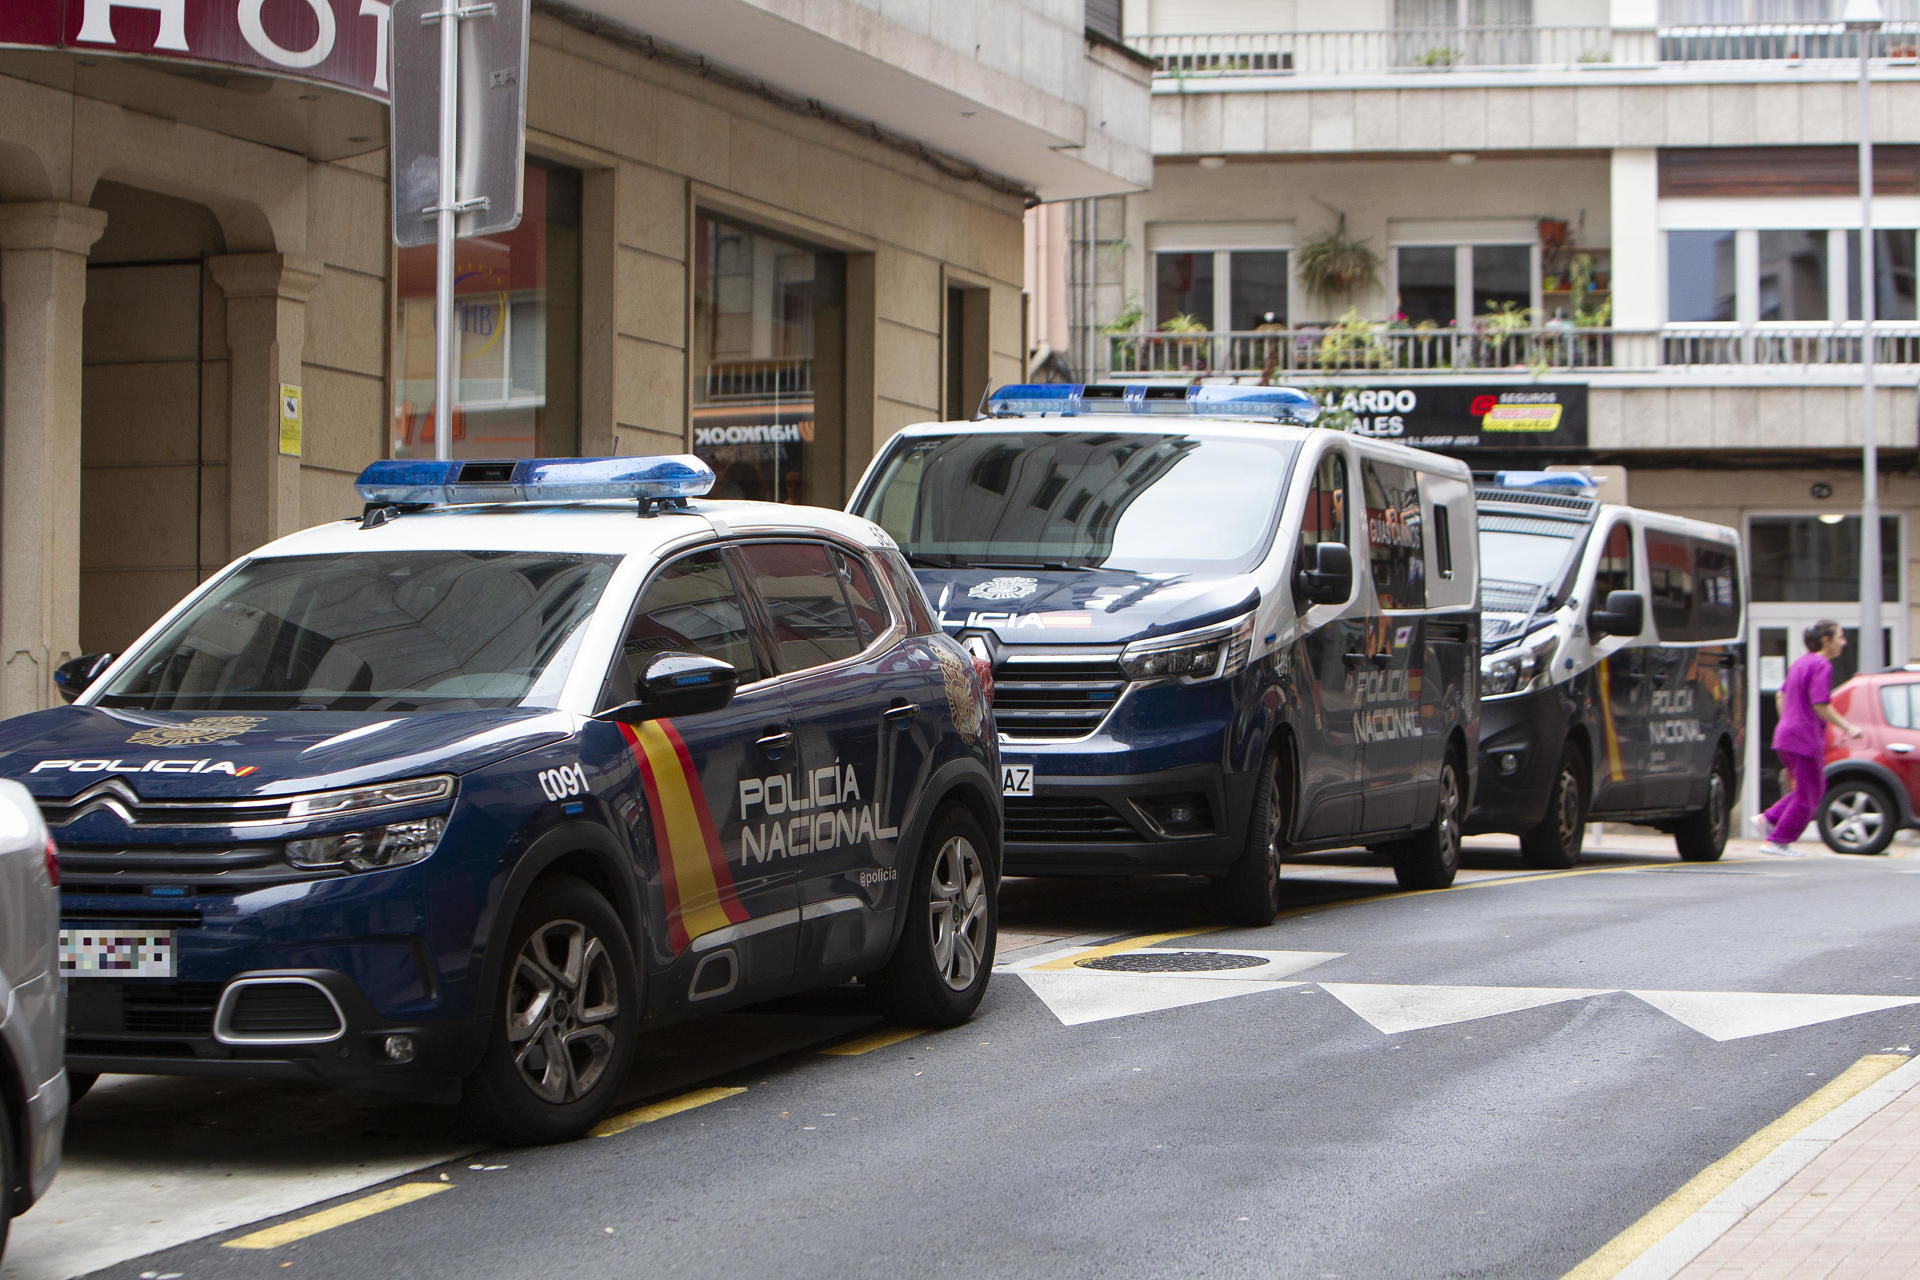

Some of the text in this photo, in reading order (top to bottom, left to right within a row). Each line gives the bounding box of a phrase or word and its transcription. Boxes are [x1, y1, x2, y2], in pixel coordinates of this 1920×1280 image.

[1320, 390, 1416, 413] LARDO
[933, 611, 1045, 630] LICIA
[1353, 706, 1423, 744] NACIONAL
[1649, 718, 1707, 744] NACIONAL
[28, 757, 237, 775] POLICÍA
[739, 756, 861, 820] POLICÍA
[1003, 769, 1030, 791] AZ
[741, 802, 898, 866] NACIONAL
[859, 866, 897, 887] @policia
